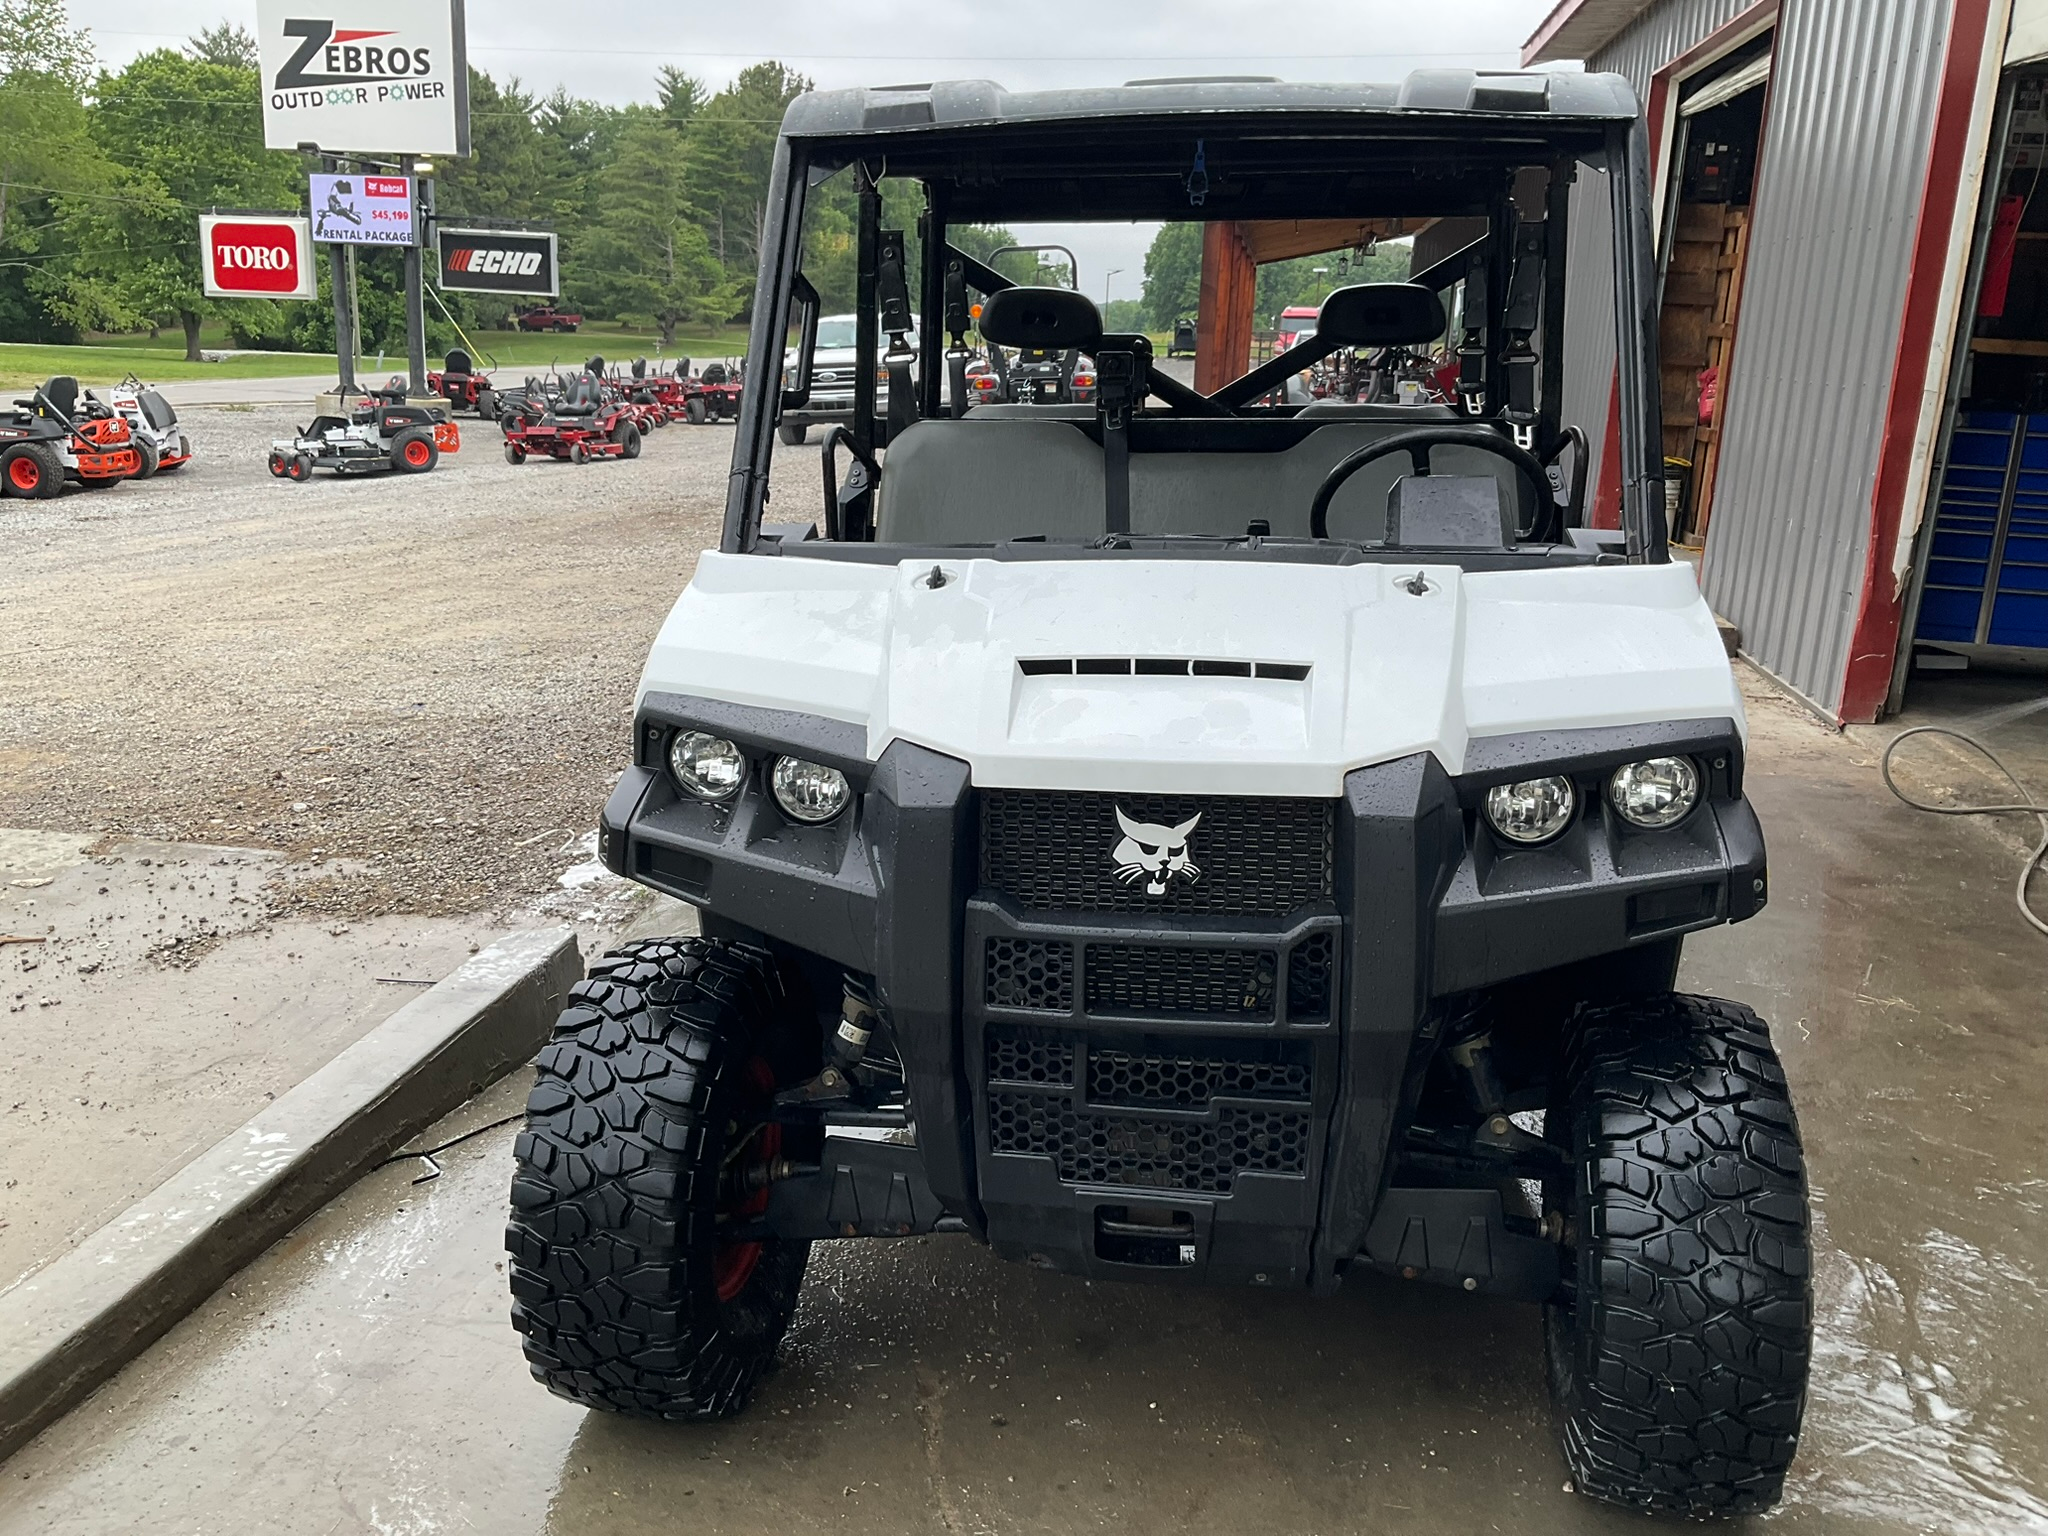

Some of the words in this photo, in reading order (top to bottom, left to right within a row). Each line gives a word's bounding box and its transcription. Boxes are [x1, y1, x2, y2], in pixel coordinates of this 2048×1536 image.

[274, 18, 431, 91] ZEBROS
[271, 87, 368, 110] OUTDOOR
[378, 82, 445, 102] POWER
[379, 183, 404, 194] Bobcat
[372, 210, 408, 221] $45,199
[323, 229, 362, 240] RENTAL
[365, 231, 413, 242] PACKAGE
[217, 245, 290, 270] TORO
[467, 249, 542, 275] ECHO
